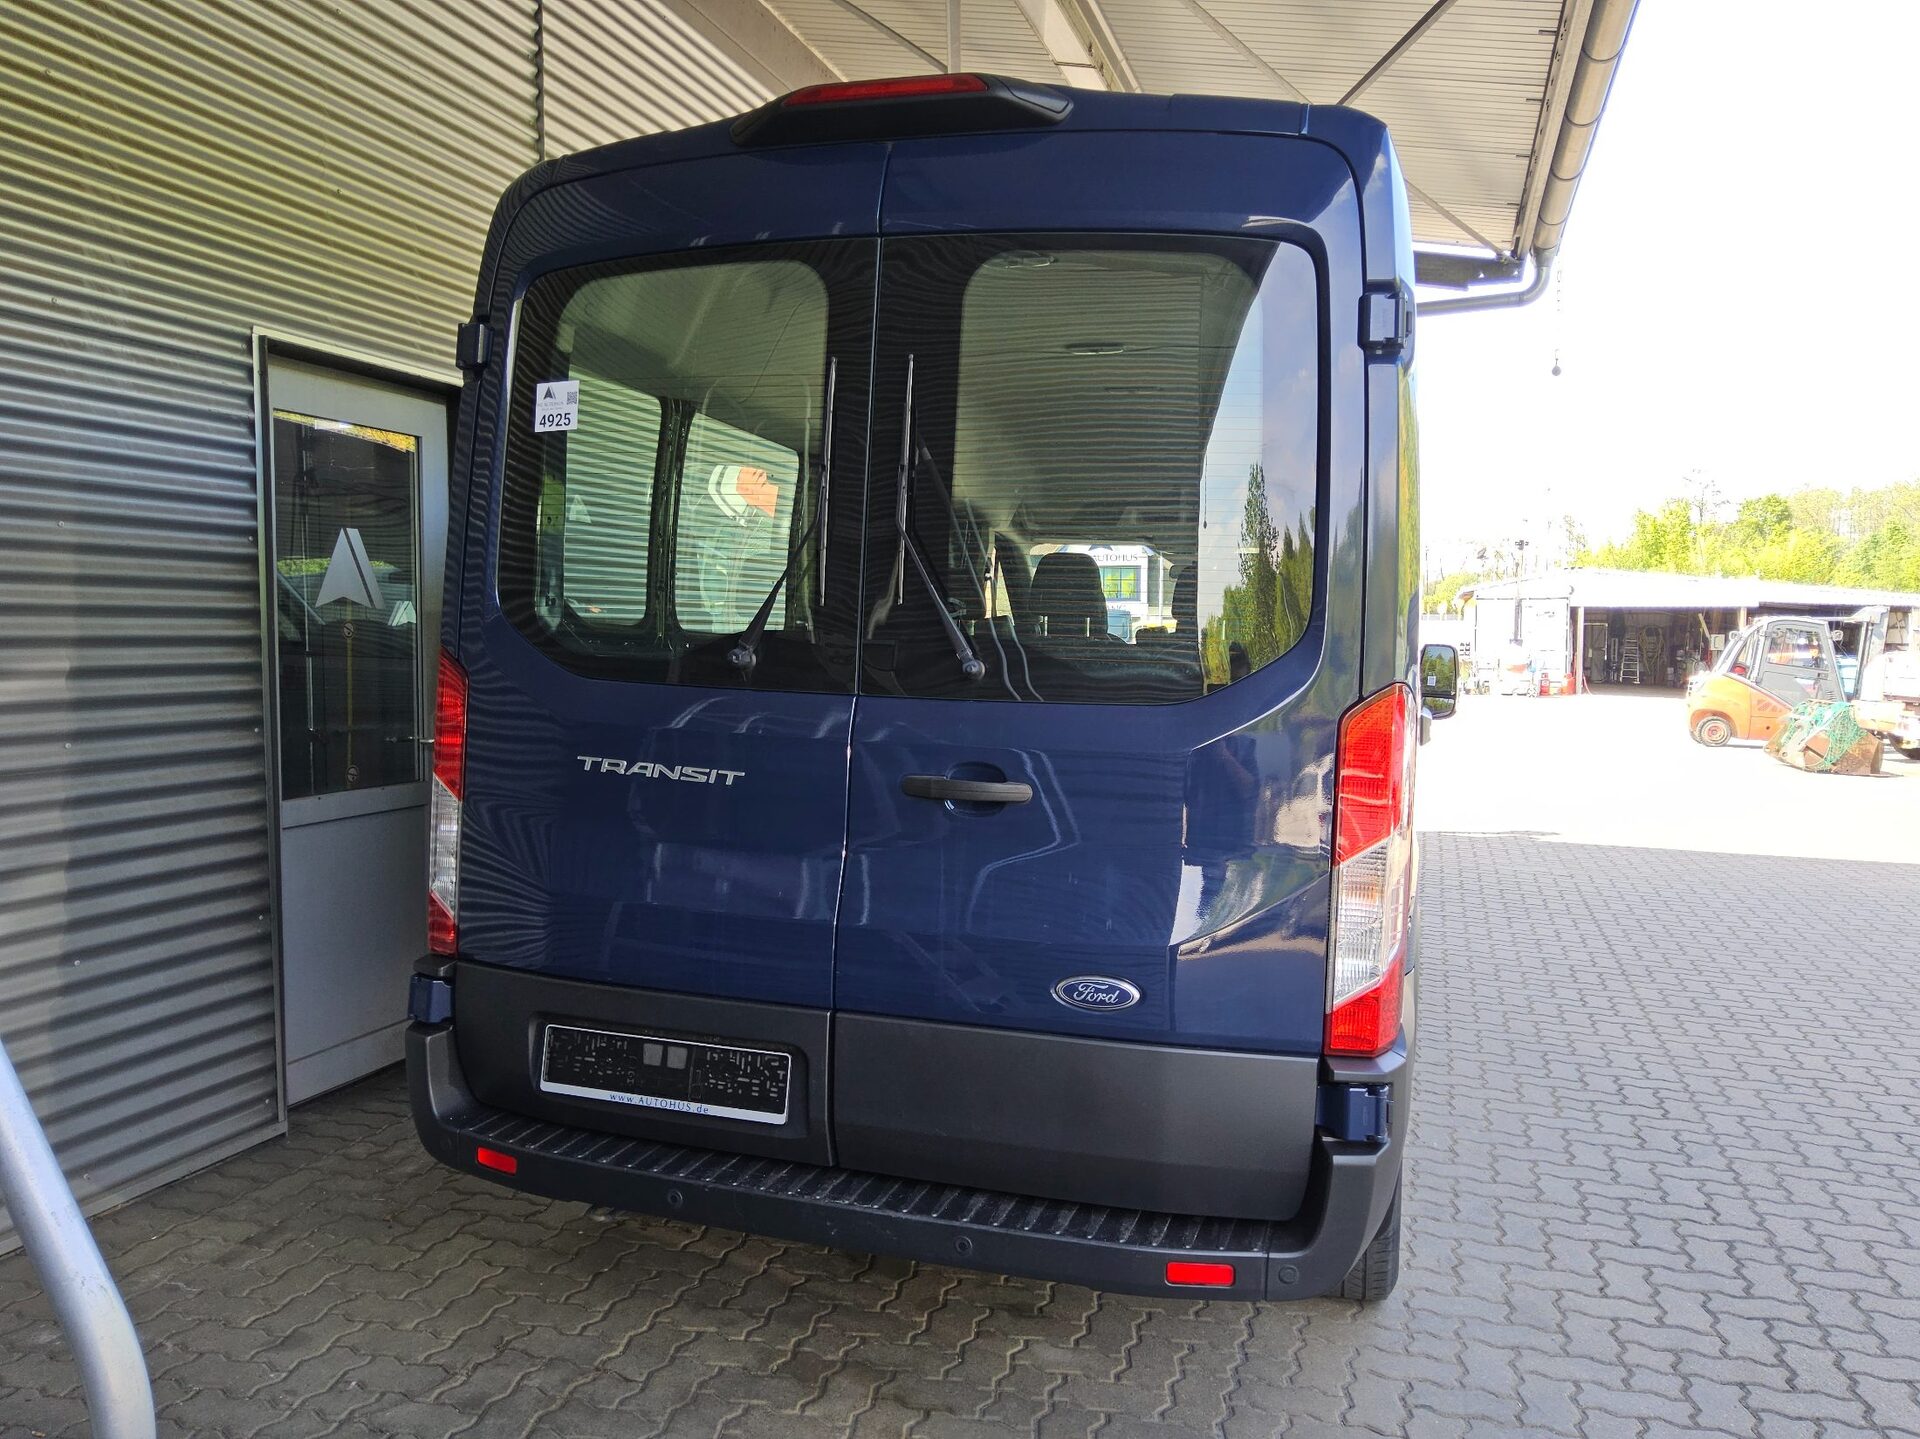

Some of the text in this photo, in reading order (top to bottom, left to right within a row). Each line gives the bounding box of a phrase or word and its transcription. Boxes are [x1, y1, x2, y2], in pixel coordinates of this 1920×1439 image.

[539, 413, 571, 428] 4925
[577, 755, 746, 786] TRANSIT
[1073, 982, 1120, 1004] Ford
[609, 1094, 709, 1114] www.AUTOHUS.de
